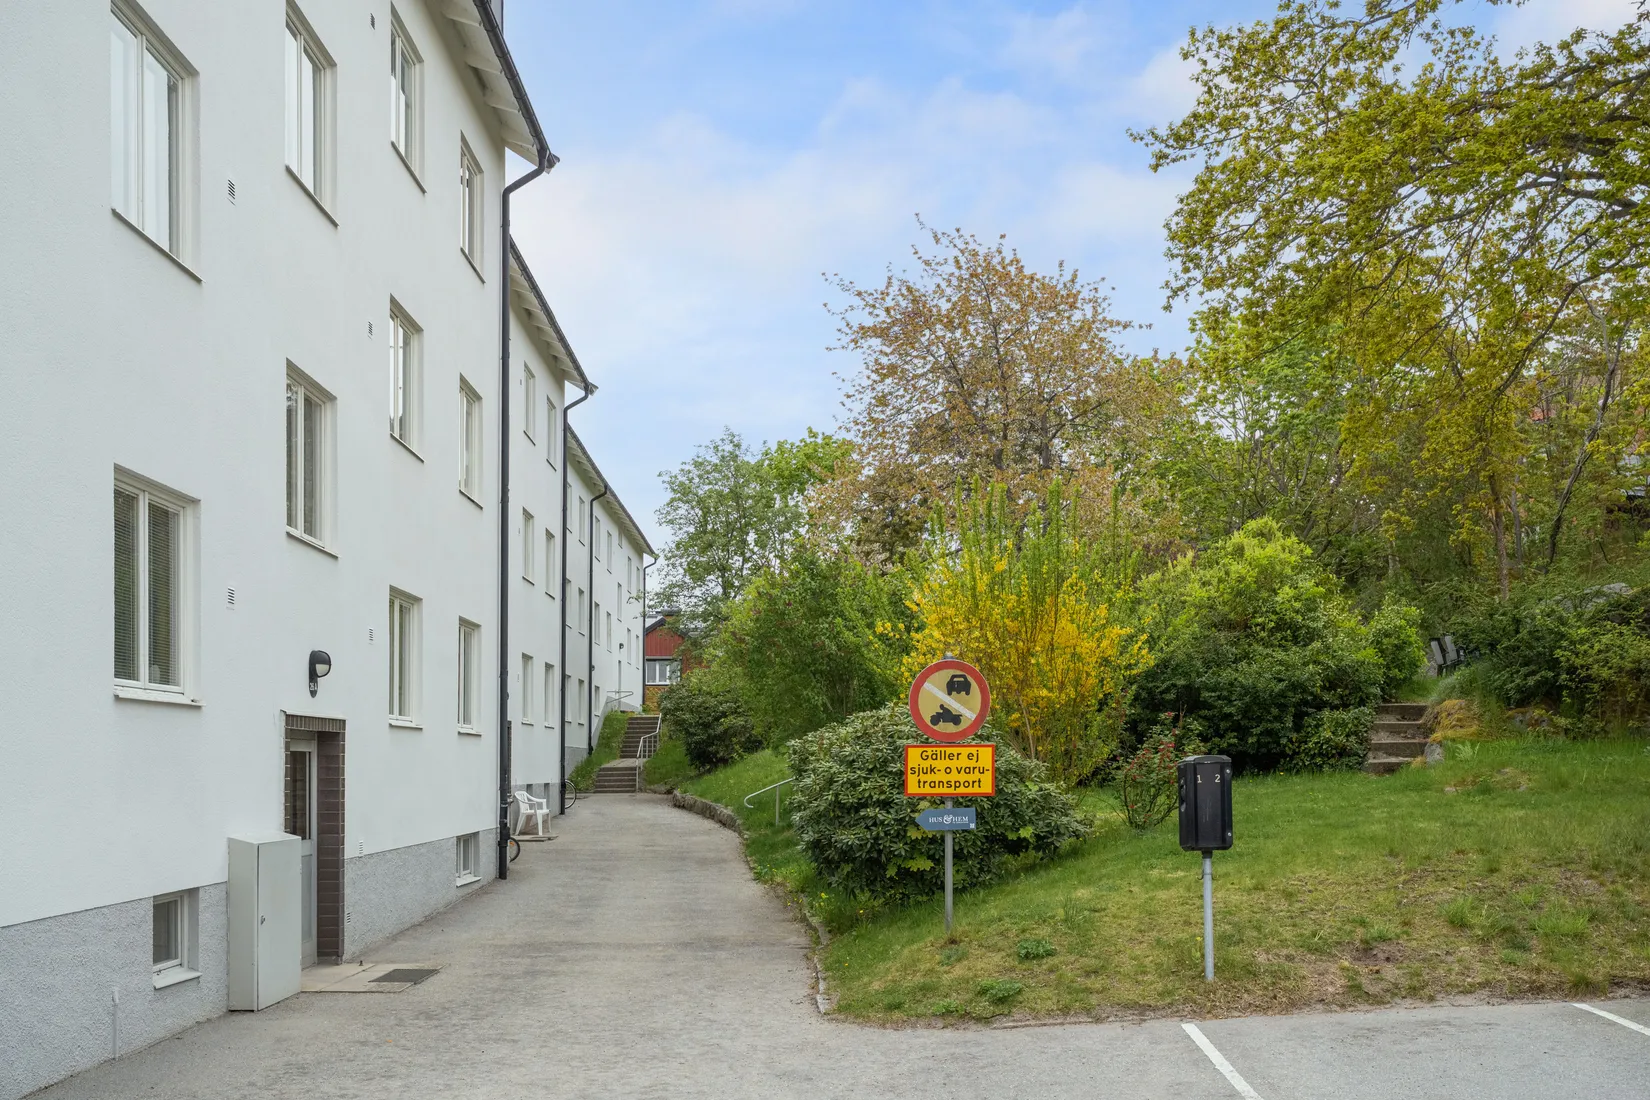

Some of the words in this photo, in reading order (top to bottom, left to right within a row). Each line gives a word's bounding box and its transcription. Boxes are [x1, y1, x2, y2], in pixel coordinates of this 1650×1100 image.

[920, 750, 961, 760] Gäller
[967, 750, 979, 763] ej
[910, 764, 941, 777] sjuk-
[944, 766, 952, 774] o
[956, 766, 990, 774] varu-
[917, 778, 982, 791] transport
[1197, 775, 1202, 783] 1
[1215, 774, 1220, 783] 2
